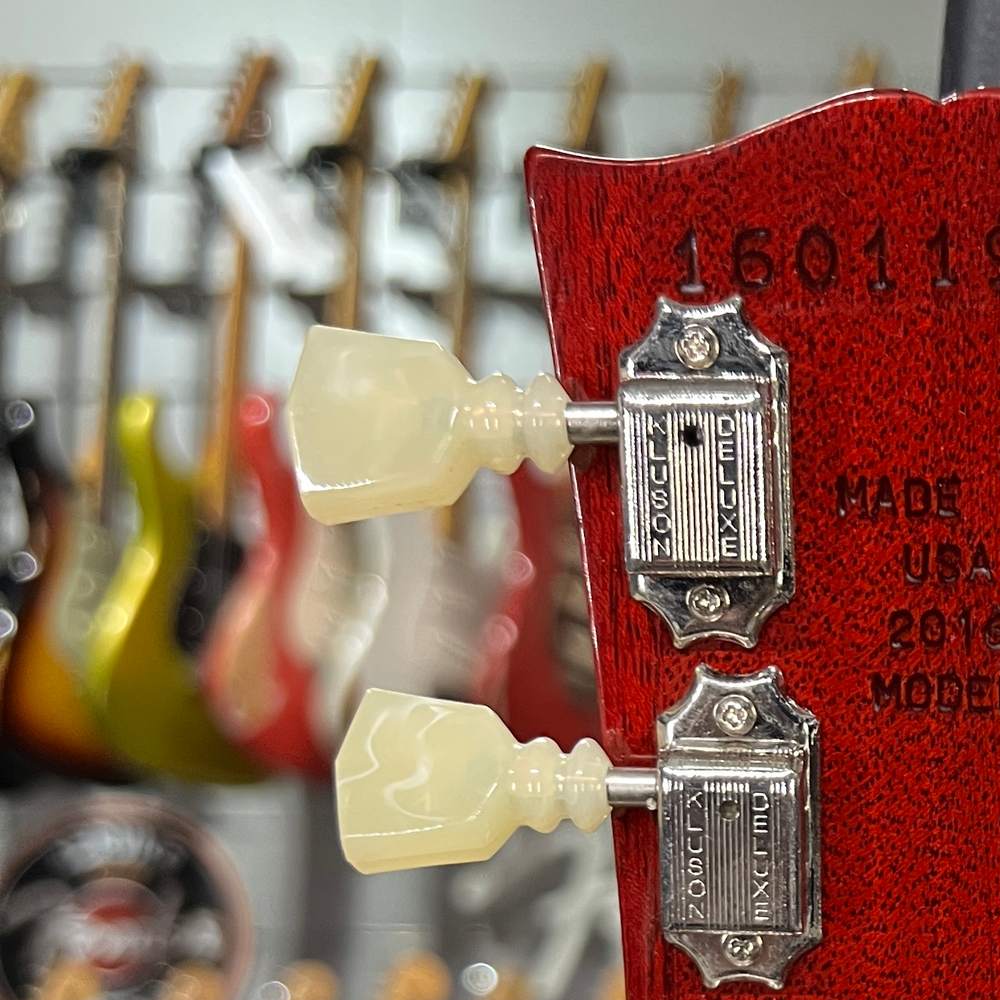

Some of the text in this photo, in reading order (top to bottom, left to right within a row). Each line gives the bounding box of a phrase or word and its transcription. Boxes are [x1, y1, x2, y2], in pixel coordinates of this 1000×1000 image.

[649, 415, 672, 557] KLUSON
[717, 415, 737, 557] DELUXE
[836, 474, 961, 519] MADE
[904, 542, 993, 583] USA
[686, 792, 706, 919] KLUSON
[752, 792, 769, 920] DELUXE
